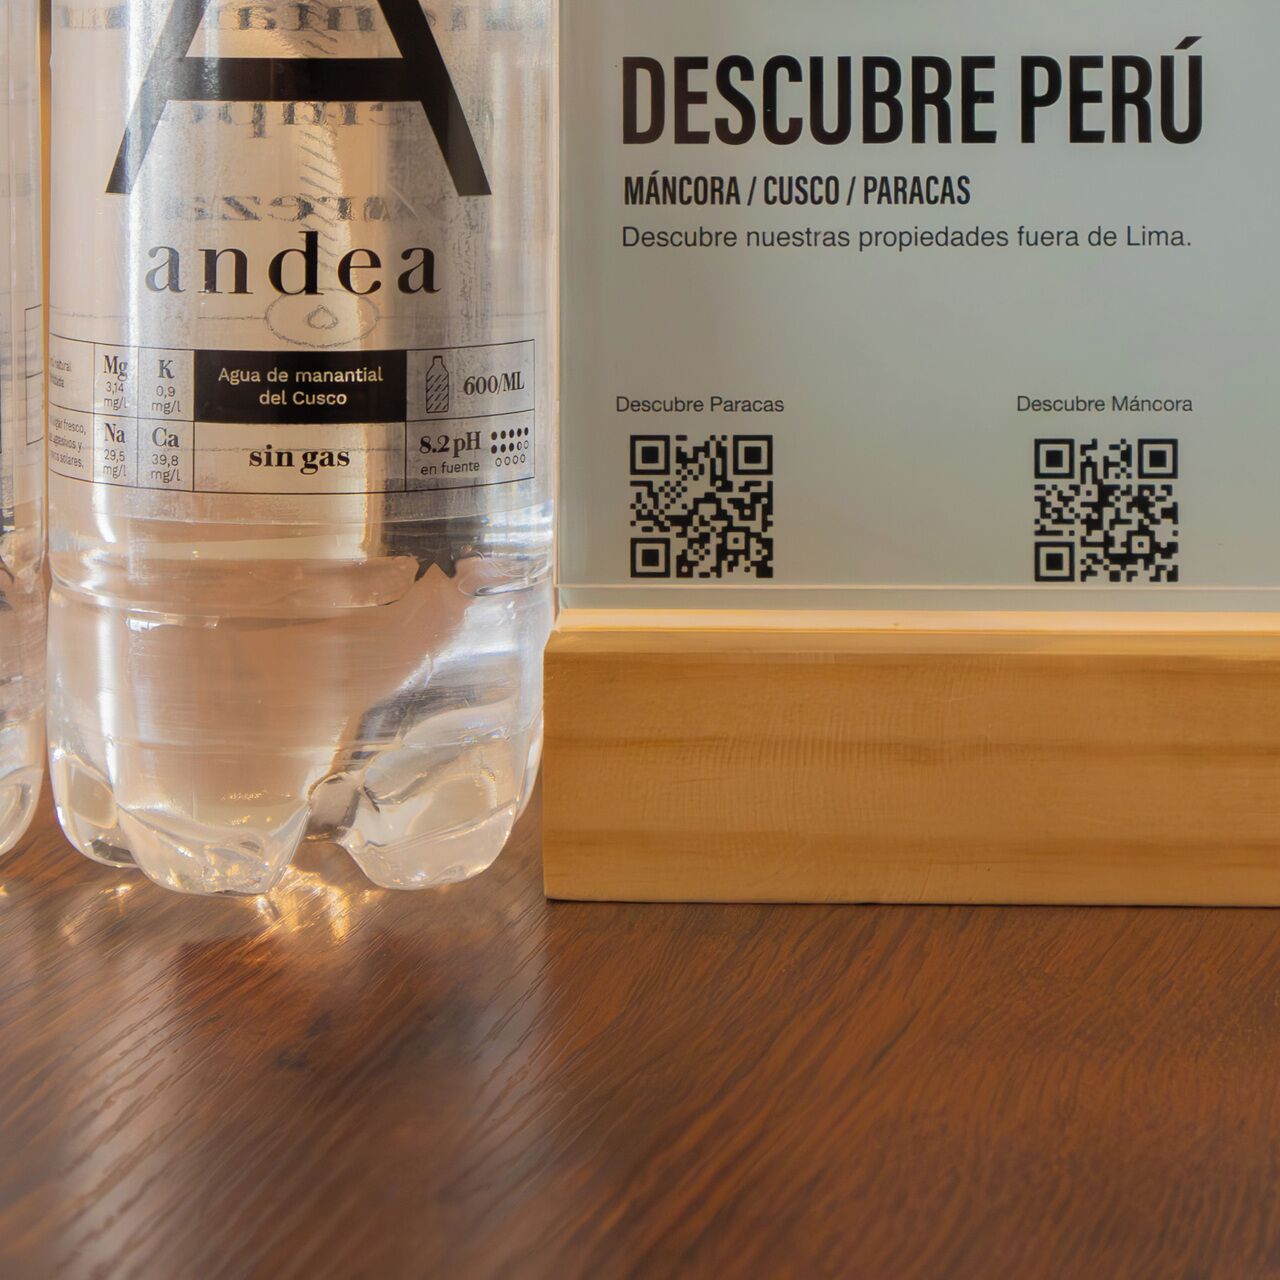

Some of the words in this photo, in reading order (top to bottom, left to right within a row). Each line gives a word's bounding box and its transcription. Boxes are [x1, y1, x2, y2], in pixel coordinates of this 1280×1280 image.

[622, 54, 997, 146] DESCUBRE
[1020, 35, 1204, 145] PERÚ
[623, 169, 741, 206] MÁNCORA
[763, 174, 840, 206] CUSCO
[863, 174, 972, 206] PARACAS
[621, 225, 738, 248] Descubre
[745, 226, 851, 248] nuestras
[858, 225, 1010, 253] propiedades
[1016, 225, 1080, 248] fuera
[1087, 225, 1118, 247] de
[1125, 224, 1193, 248] Lima.
[144, 231, 442, 296] andea
[103, 354, 129, 382] Mg
[158, 359, 175, 380] K
[218, 367, 262, 386] Agua
[266, 367, 290, 383] de
[295, 366, 385, 383] manantial
[105, 380, 125, 395] 3,14
[463, 370, 526, 396] 600/ML
[155, 385, 177, 400] 0,9
[258, 390, 288, 406] del
[292, 391, 348, 406] Cusco
[103, 397, 128, 412] mg/l
[151, 400, 182, 415] mg/l
[615, 395, 705, 413] Descubre
[709, 395, 785, 413] Paracas
[1016, 394, 1106, 412] Descubre
[1111, 394, 1194, 412] Máncora
[103, 422, 126, 444] Na
[151, 426, 180, 448] Ca
[104, 448, 126, 464] 29,5
[151, 453, 180, 469] 39,8
[248, 443, 295, 468] sin
[299, 449, 351, 476] gas
[103, 464, 128, 480] mg/l
[150, 468, 181, 484] mg/l
[420, 464, 438, 476] en
[441, 461, 481, 475] fuente
